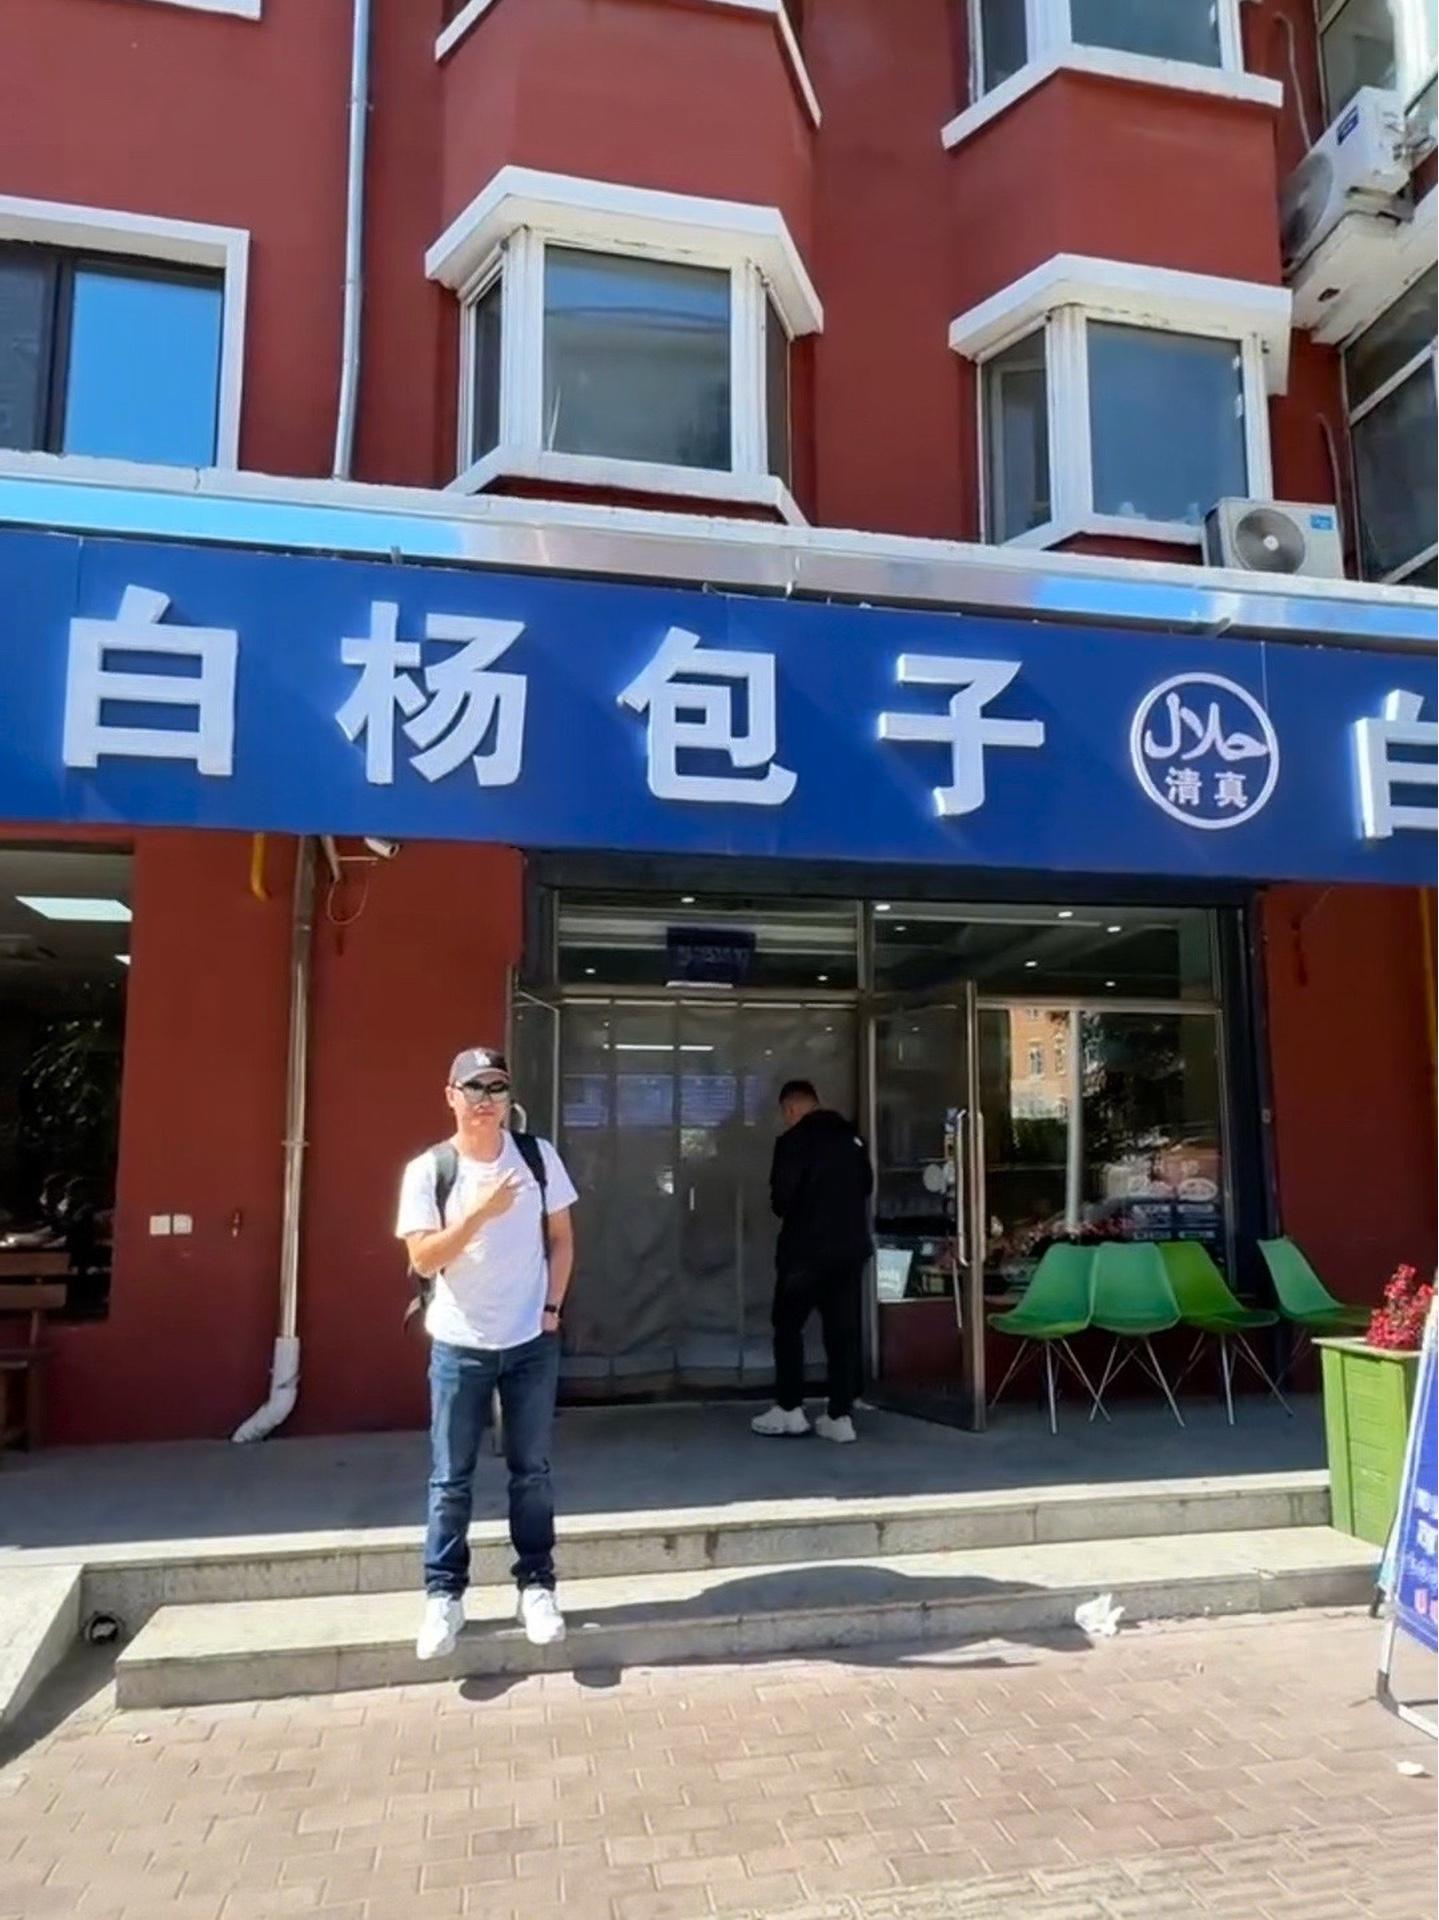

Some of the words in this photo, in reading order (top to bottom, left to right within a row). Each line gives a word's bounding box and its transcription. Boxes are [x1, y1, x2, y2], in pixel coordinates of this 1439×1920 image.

[63, 583, 1045, 816] 白杨包子
[1144, 691, 1268, 761] حلال
[1165, 766, 1249, 809] 清真
